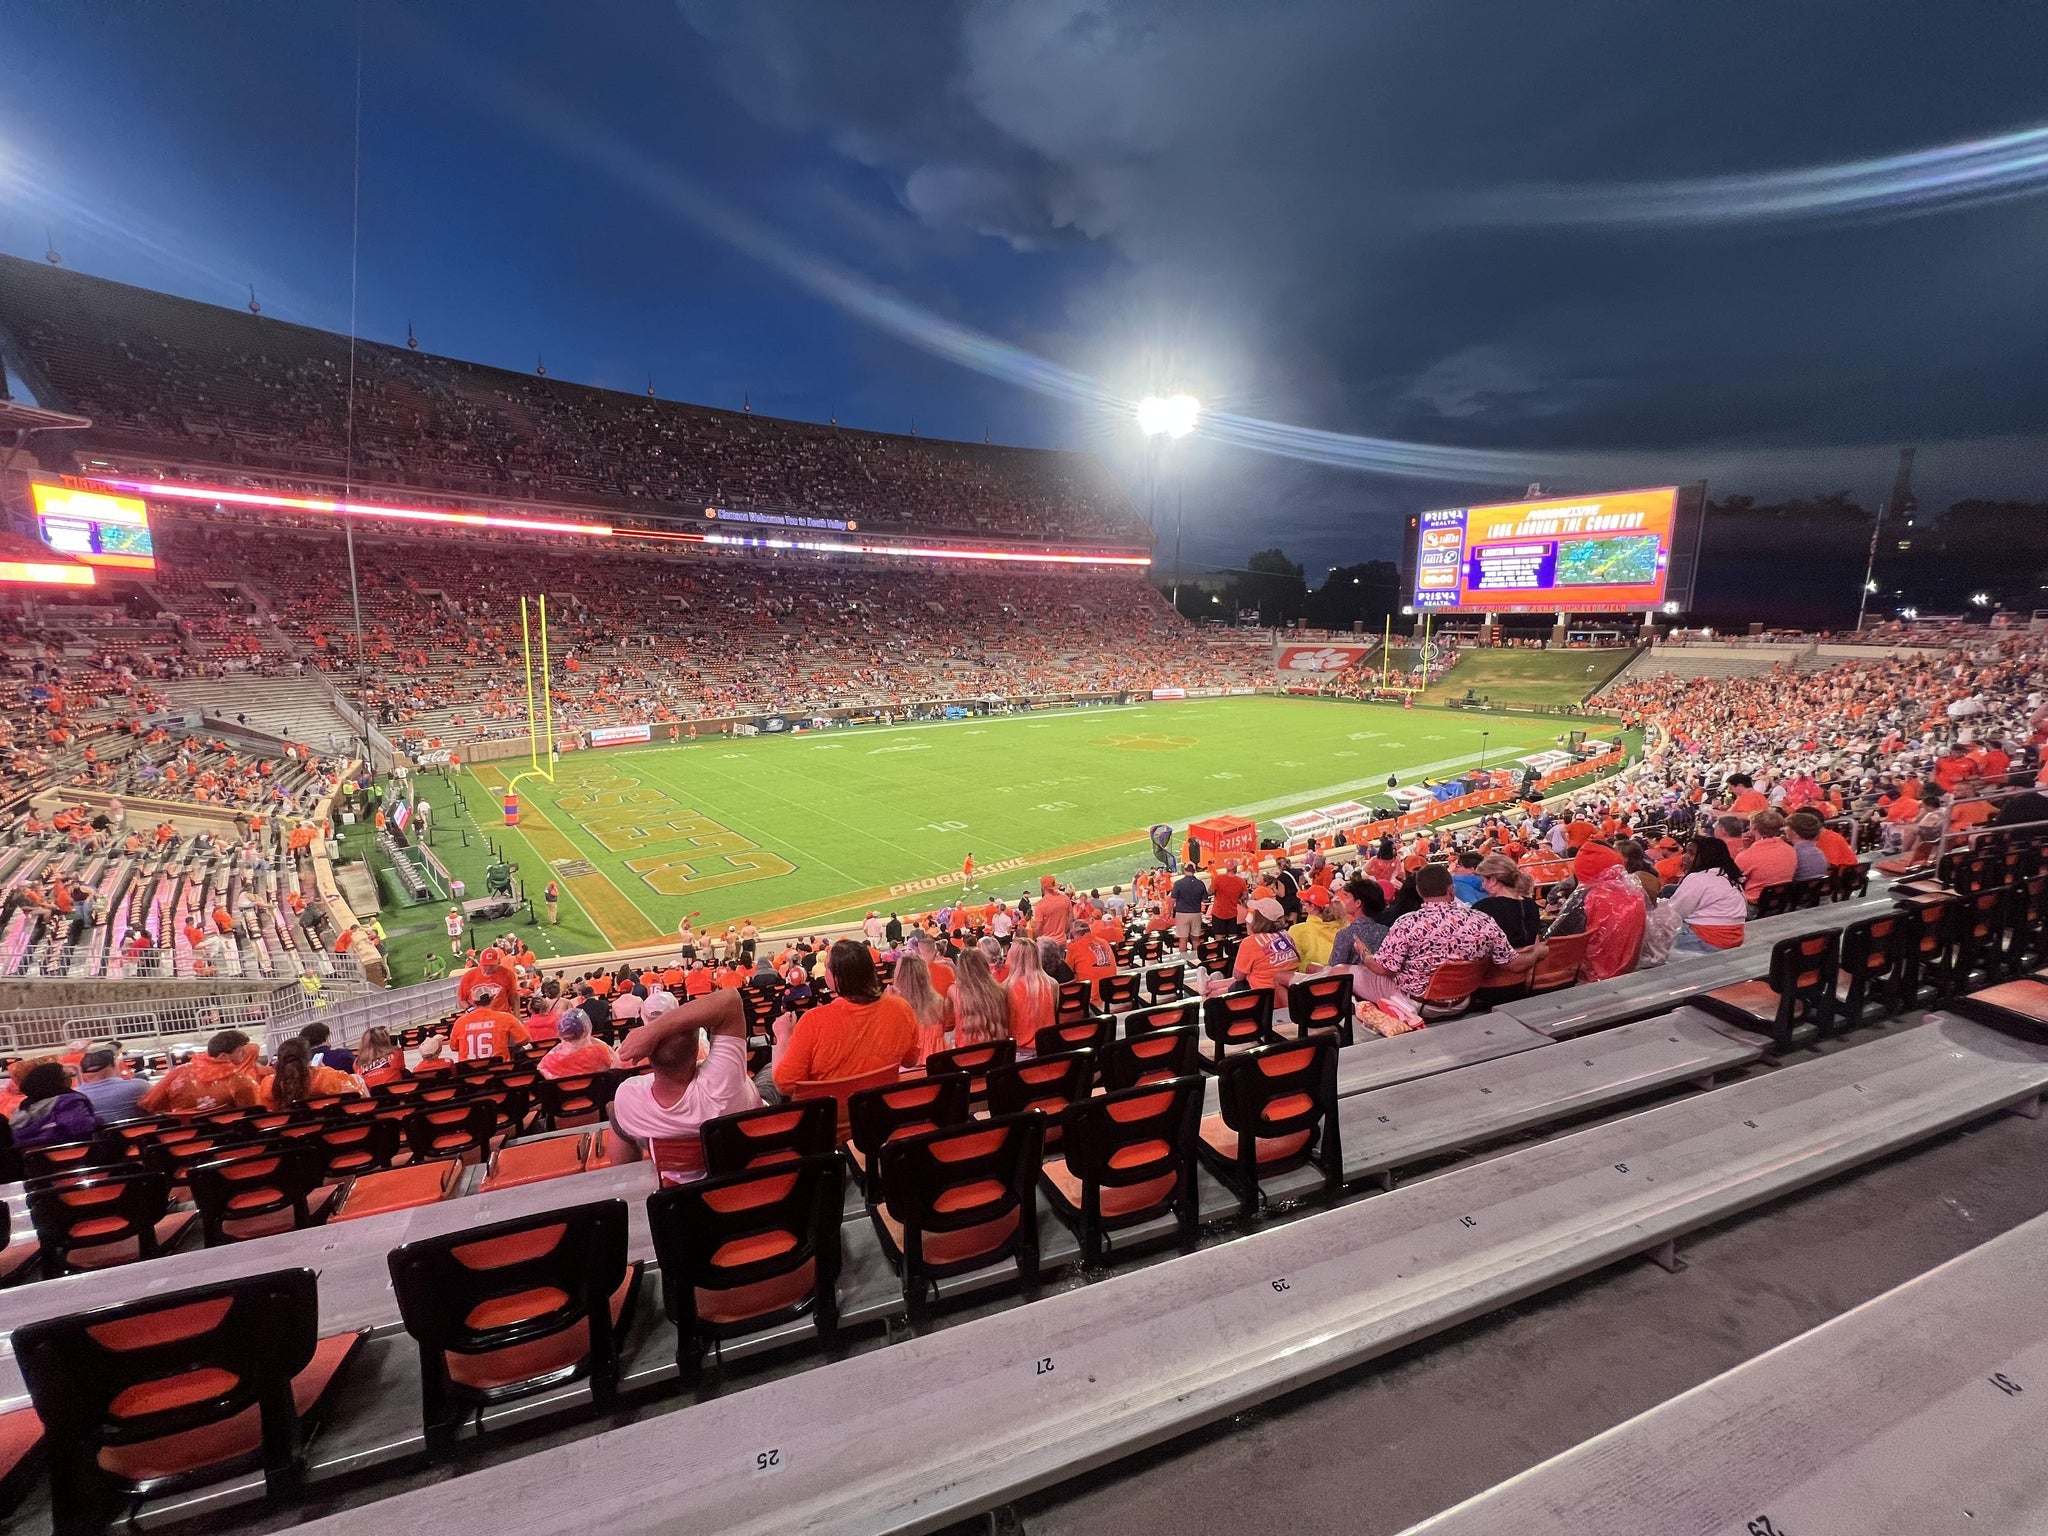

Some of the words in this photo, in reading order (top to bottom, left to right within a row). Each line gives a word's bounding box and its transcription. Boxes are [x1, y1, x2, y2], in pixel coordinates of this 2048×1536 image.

[718, 509, 749, 521] Clemson
[785, 515, 799, 526] You
[799, 517, 807, 526] to
[1424, 510, 1464, 521] PRISMA
[1487, 523, 1513, 538] LOOK
[1515, 519, 1559, 536] AROUND
[1561, 517, 1584, 532] THE
[1585, 512, 1645, 531] COUNTRY
[1418, 591, 1456, 601] PRISMA
[1413, 663, 1444, 673] Alltate
[1037, 800, 1078, 812] 20
[927, 820, 969, 832] 10
[1220, 832, 1253, 850] PRISMA
[486, 952, 494, 960] C
[466, 1032, 494, 1060] 16
[1459, 1215, 1477, 1229] 31
[1271, 1278, 1291, 1294] 29
[1036, 1357, 1055, 1375] 27
[1987, 1372, 2025, 1397] 31
[756, 1448, 780, 1471] 25
[1746, 1513, 1786, 1536] 29
